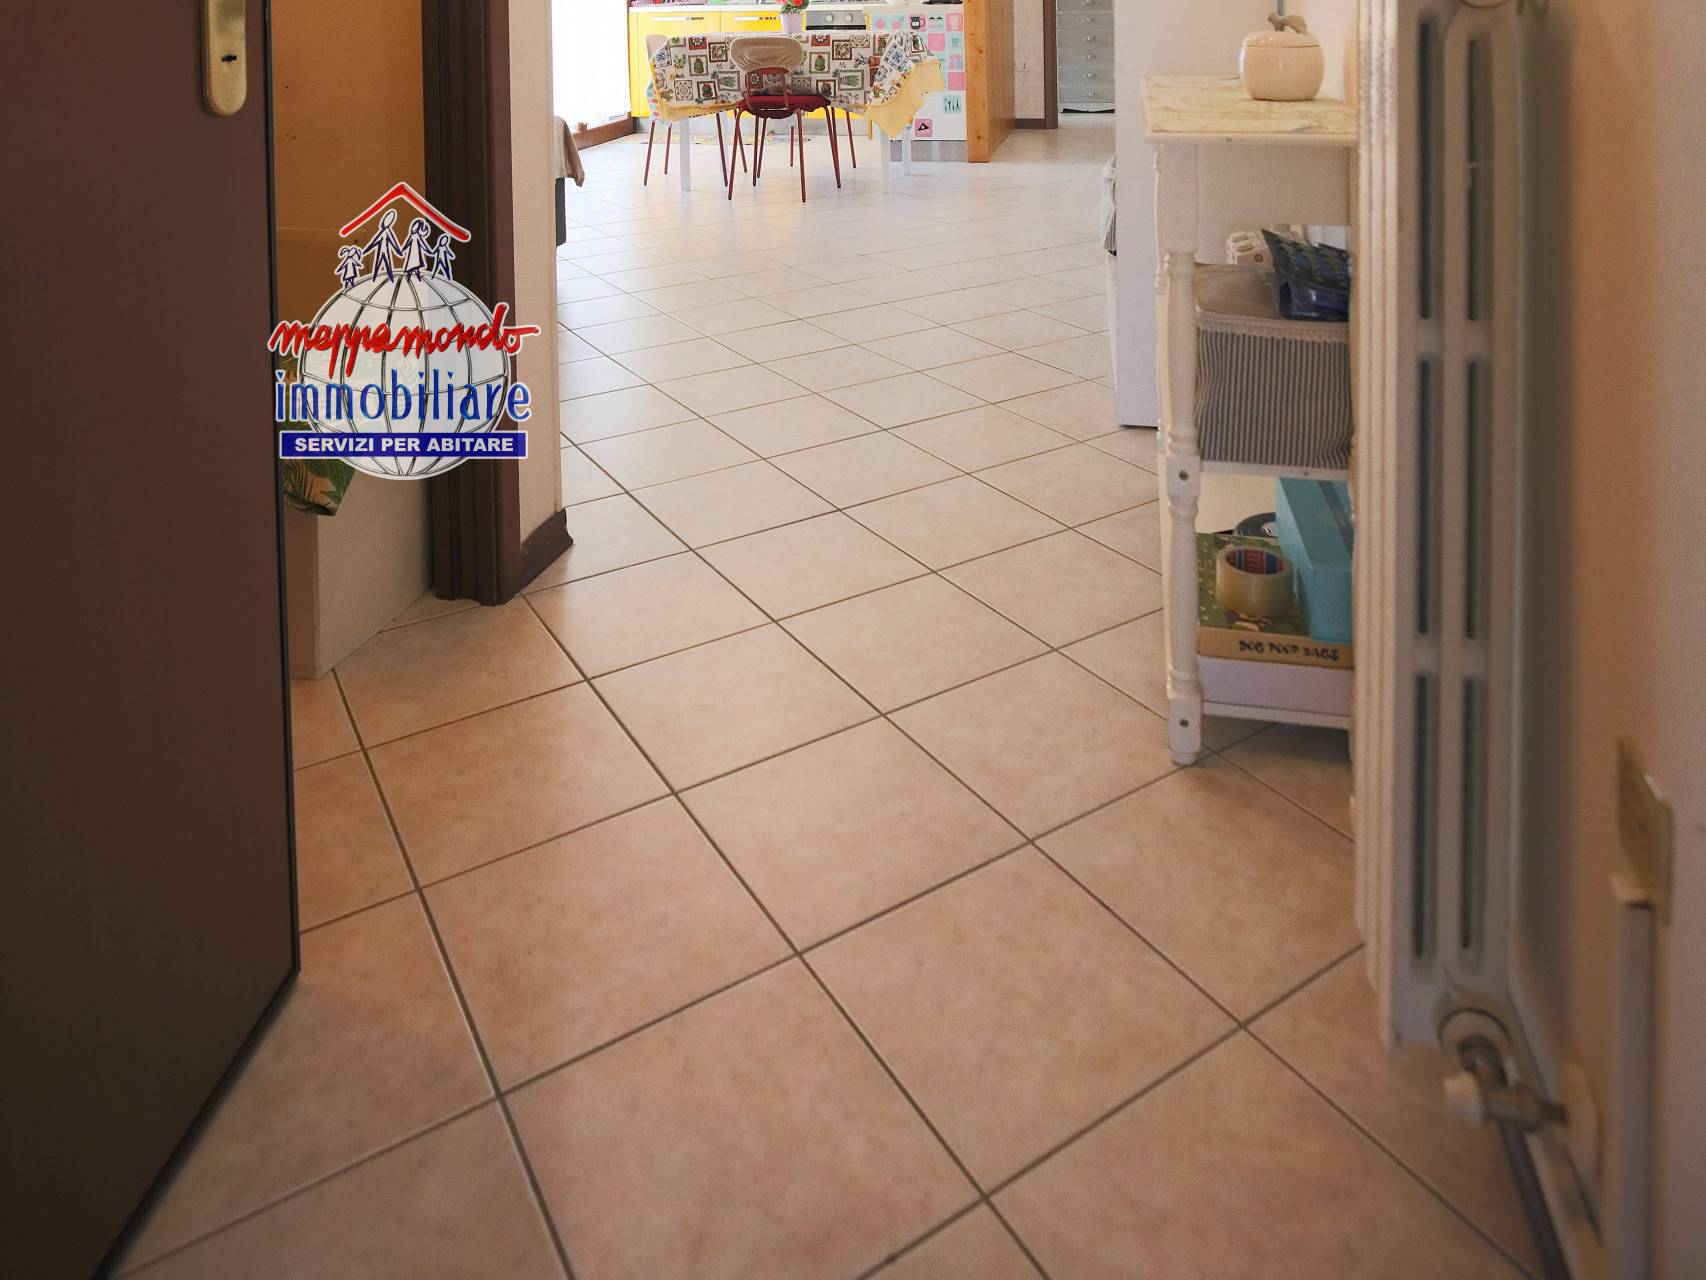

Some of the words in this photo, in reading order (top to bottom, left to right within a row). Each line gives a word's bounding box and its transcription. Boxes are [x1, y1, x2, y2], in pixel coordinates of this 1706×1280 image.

[1239, 640, 1264, 653] DOG
[1269, 642, 1299, 654] POOP
[1304, 647, 1339, 661] BAGS
